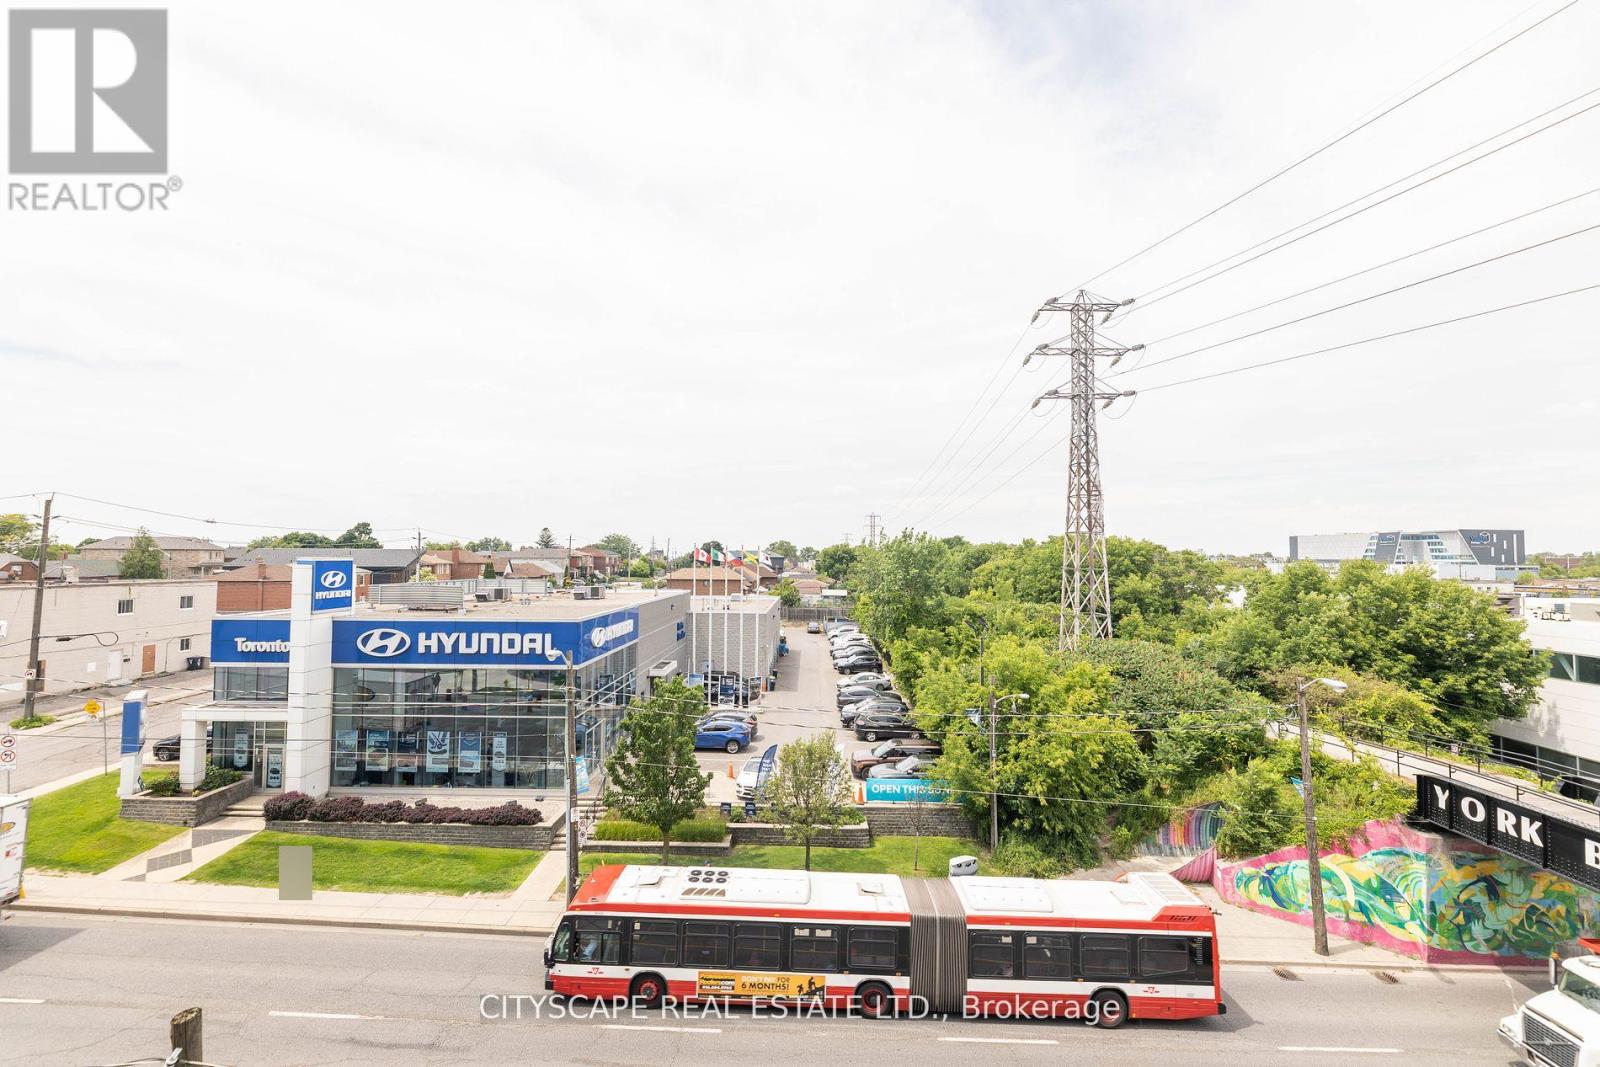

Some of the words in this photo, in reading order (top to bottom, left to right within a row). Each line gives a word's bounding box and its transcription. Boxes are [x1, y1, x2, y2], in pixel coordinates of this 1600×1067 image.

[315, 589, 351, 599] HYUNDAI
[234, 637, 290, 652] Toronto
[418, 632, 551, 654] HYUNDAI
[871, 784, 901, 794] OPEN
[1433, 784, 1544, 848] YORK
[741, 981, 747, 989] 6
[749, 982, 790, 991] MONTHS!
